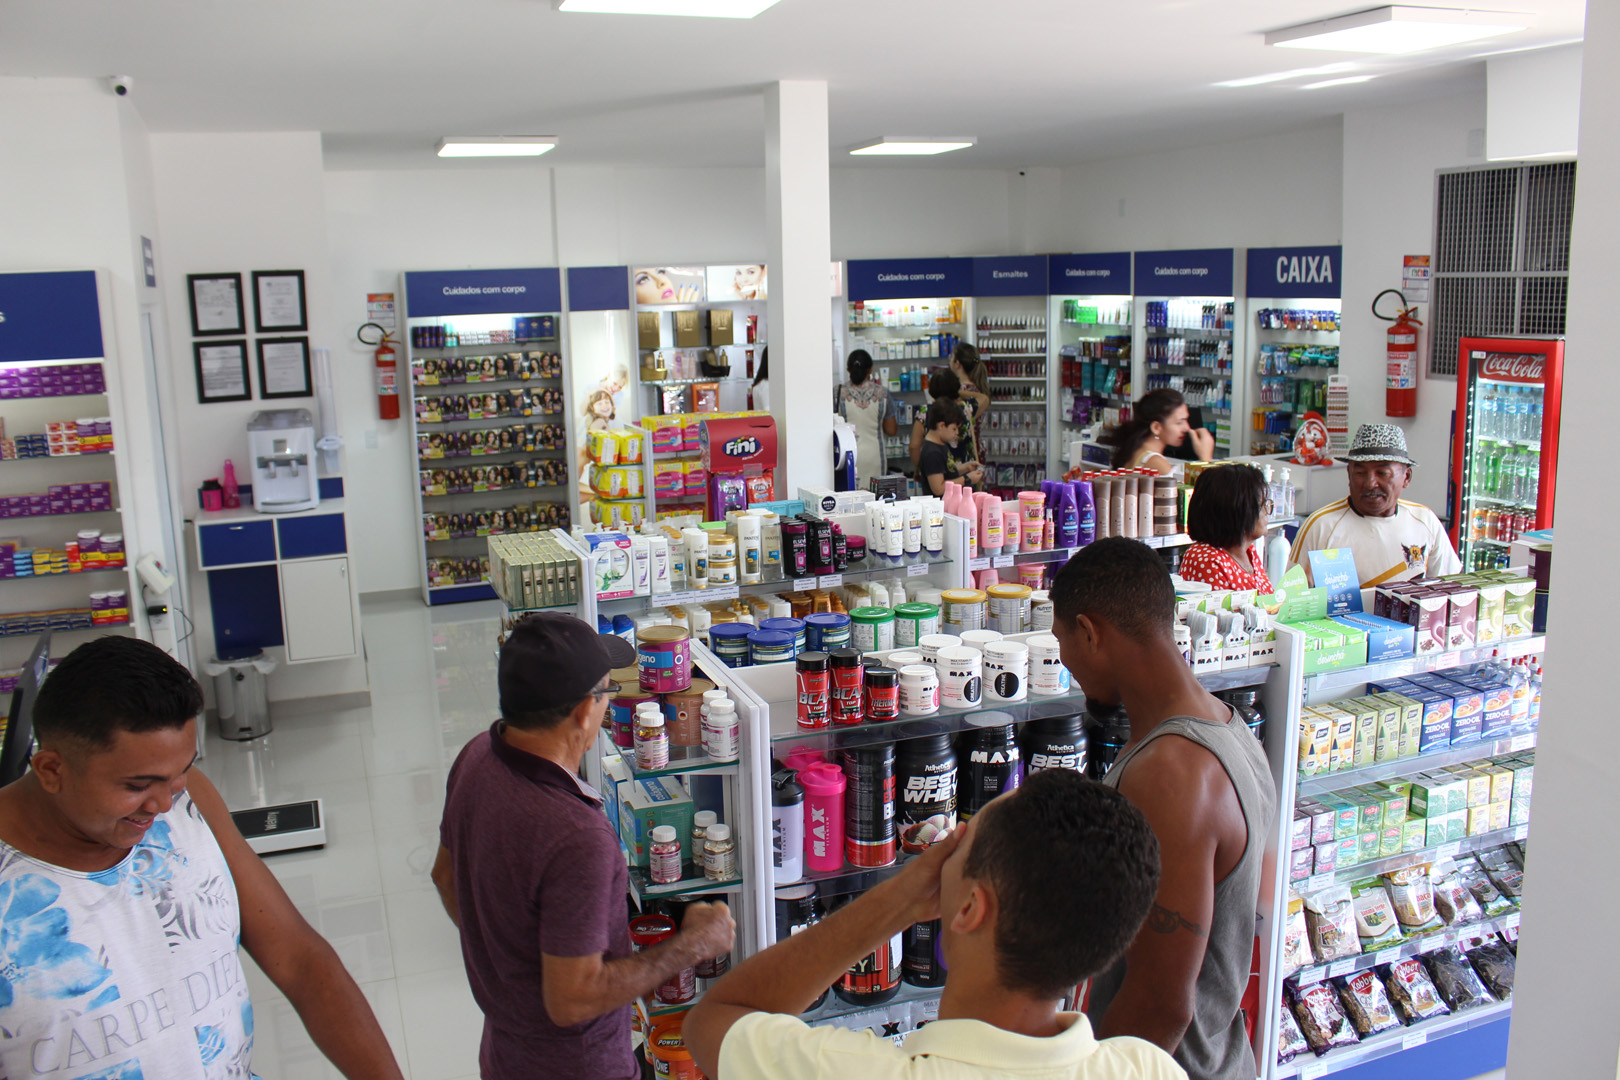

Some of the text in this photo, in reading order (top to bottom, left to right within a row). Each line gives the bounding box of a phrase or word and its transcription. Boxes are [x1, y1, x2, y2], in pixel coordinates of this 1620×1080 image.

[992, 270, 1028, 278] Esmaltes
[1066, 268, 1086, 276] Cuidados
[1097, 269, 1110, 278] corpo
[1154, 267, 1178, 276] Cuidados
[1192, 267, 1208, 277] corpo
[1276, 255, 1333, 283] CAIXA
[878, 274, 908, 282] Cuidados
[926, 273, 946, 282] corpo
[442, 286, 480, 296] Cuidados
[502, 286, 526, 294] corpo
[726, 436, 756, 456] Fini
[1226, 653, 1246, 661] MAX
[1253, 648, 1274, 656] MAX
[985, 662, 1004, 670] MAX
[970, 747, 1019, 764] MAX
[1030, 750, 1086, 768] BEST
[906, 767, 958, 790] BEST
[904, 778, 958, 804] WHEY
[811, 808, 826, 857] MAX
[772, 818, 782, 868] MAX
[1351, 974, 1375, 990] Kobber
[30, 988, 176, 1076] CARPE
[655, 1060, 669, 1074] ONE
